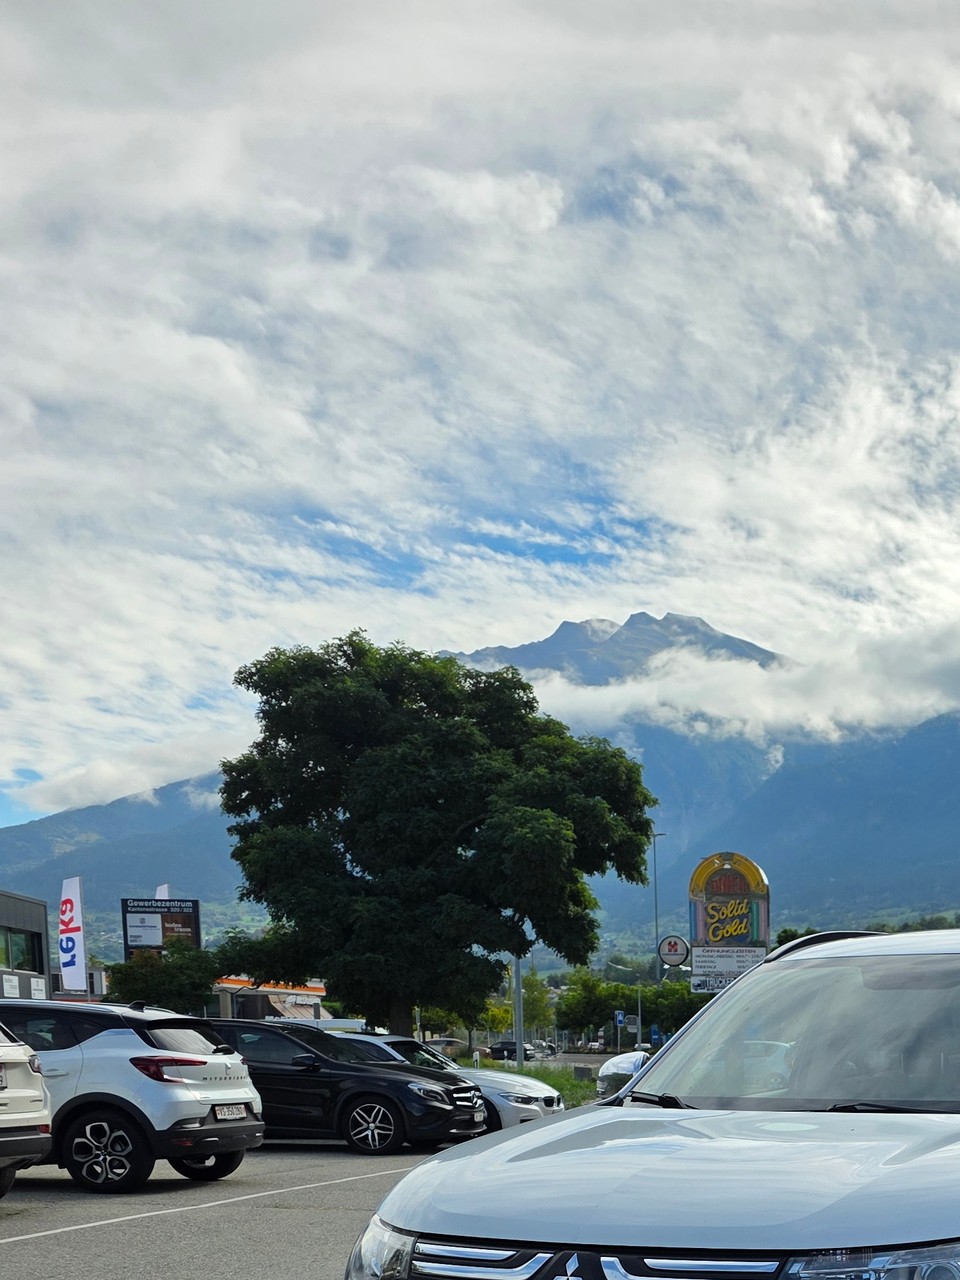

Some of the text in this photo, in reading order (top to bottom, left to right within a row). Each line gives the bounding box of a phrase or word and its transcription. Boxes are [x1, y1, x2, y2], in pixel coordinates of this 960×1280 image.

[127, 899, 193, 907] Gewerbezentrum
[706, 899, 749, 923] Solid
[59, 898, 82, 969] reka
[708, 918, 748, 942] Gold
